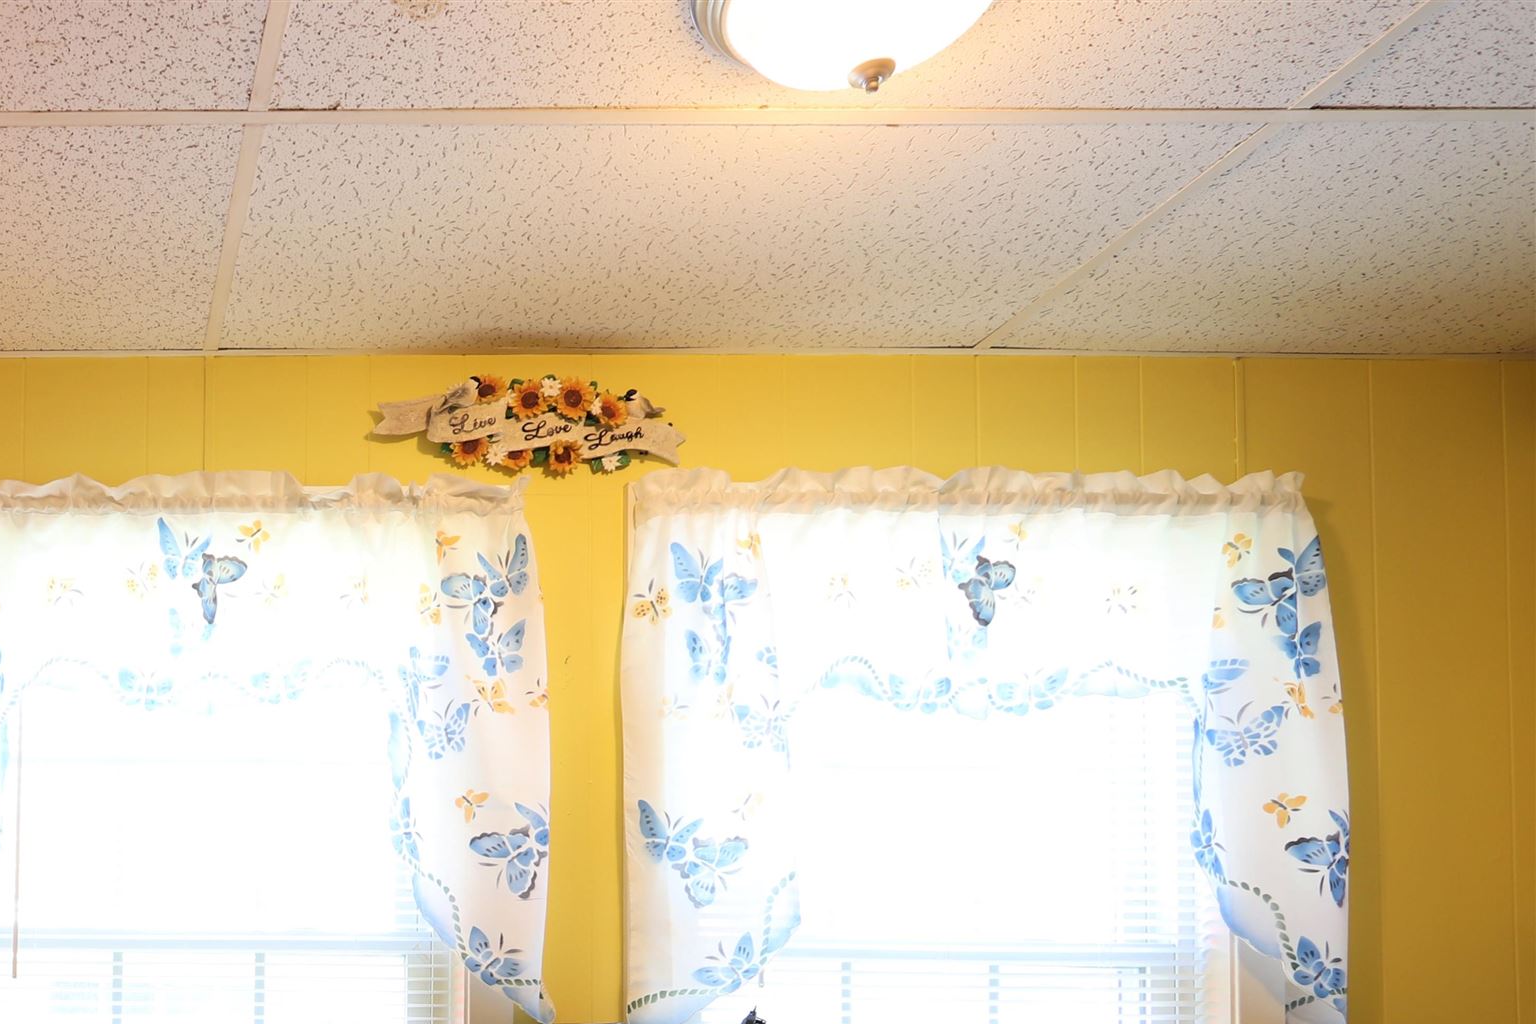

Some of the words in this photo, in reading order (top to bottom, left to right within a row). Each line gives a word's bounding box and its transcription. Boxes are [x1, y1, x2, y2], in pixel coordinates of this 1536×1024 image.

[449, 413, 496, 435] Live
[521, 420, 573, 441] Love
[584, 427, 645, 450] Laugh
